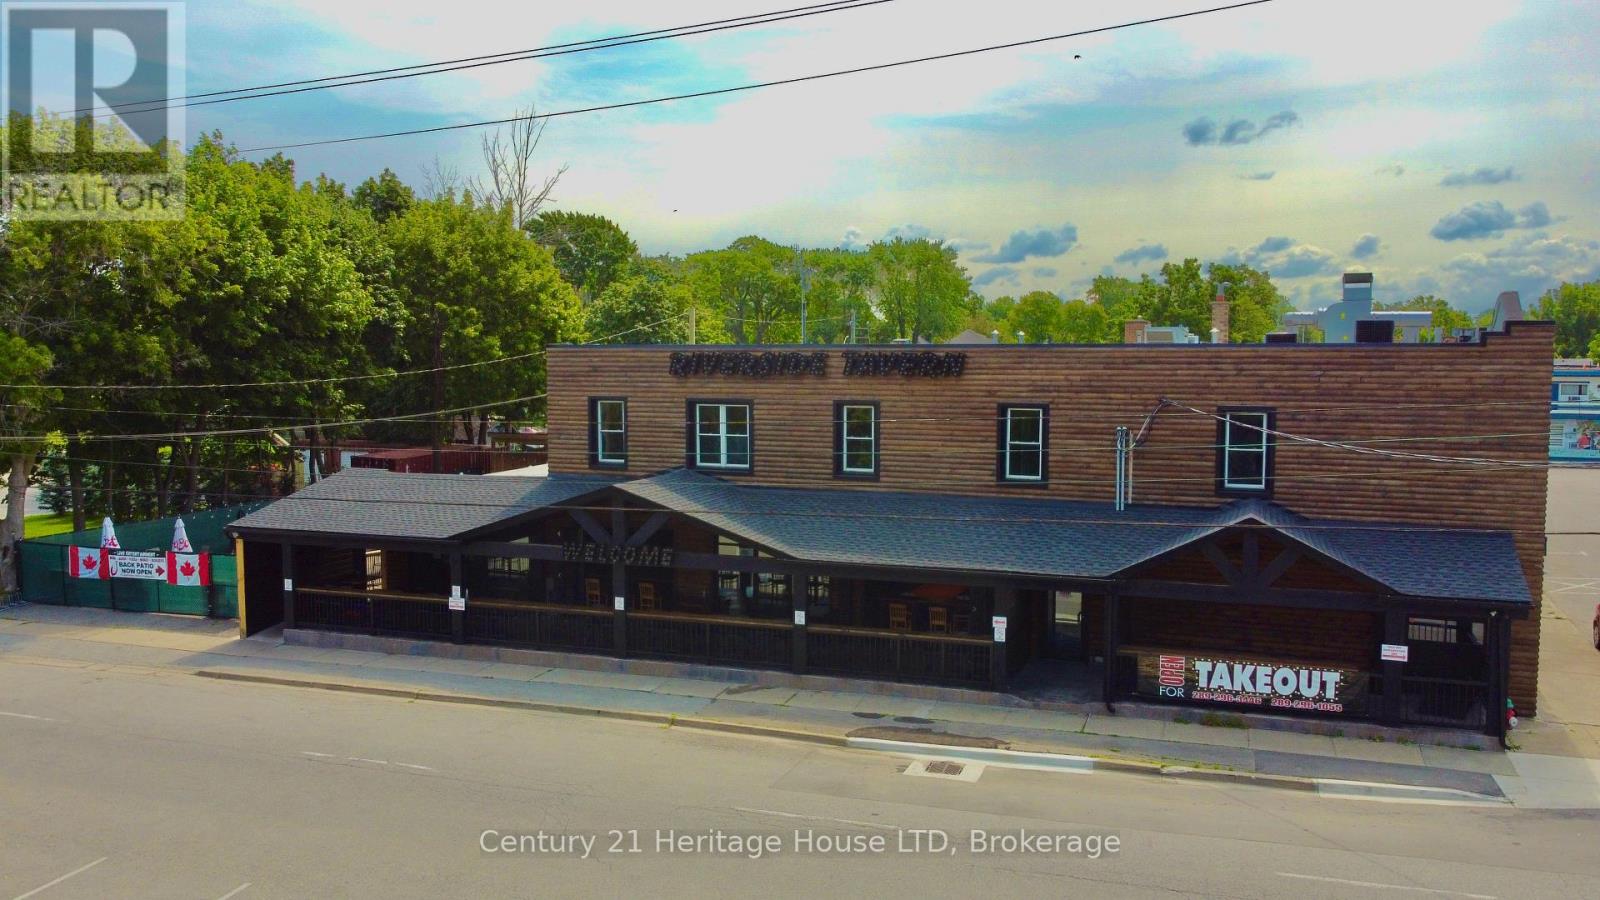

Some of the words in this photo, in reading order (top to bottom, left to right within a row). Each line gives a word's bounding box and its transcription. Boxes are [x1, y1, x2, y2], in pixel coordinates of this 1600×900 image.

[669, 351, 827, 377] RIVERSIDE
[842, 351, 966, 378] TAVERN
[563, 542, 673, 567] WELCOME
[1159, 655, 1185, 687] OPEN
[1195, 660, 1341, 699] TAKEOUT
[1159, 686, 1185, 698] FOR
